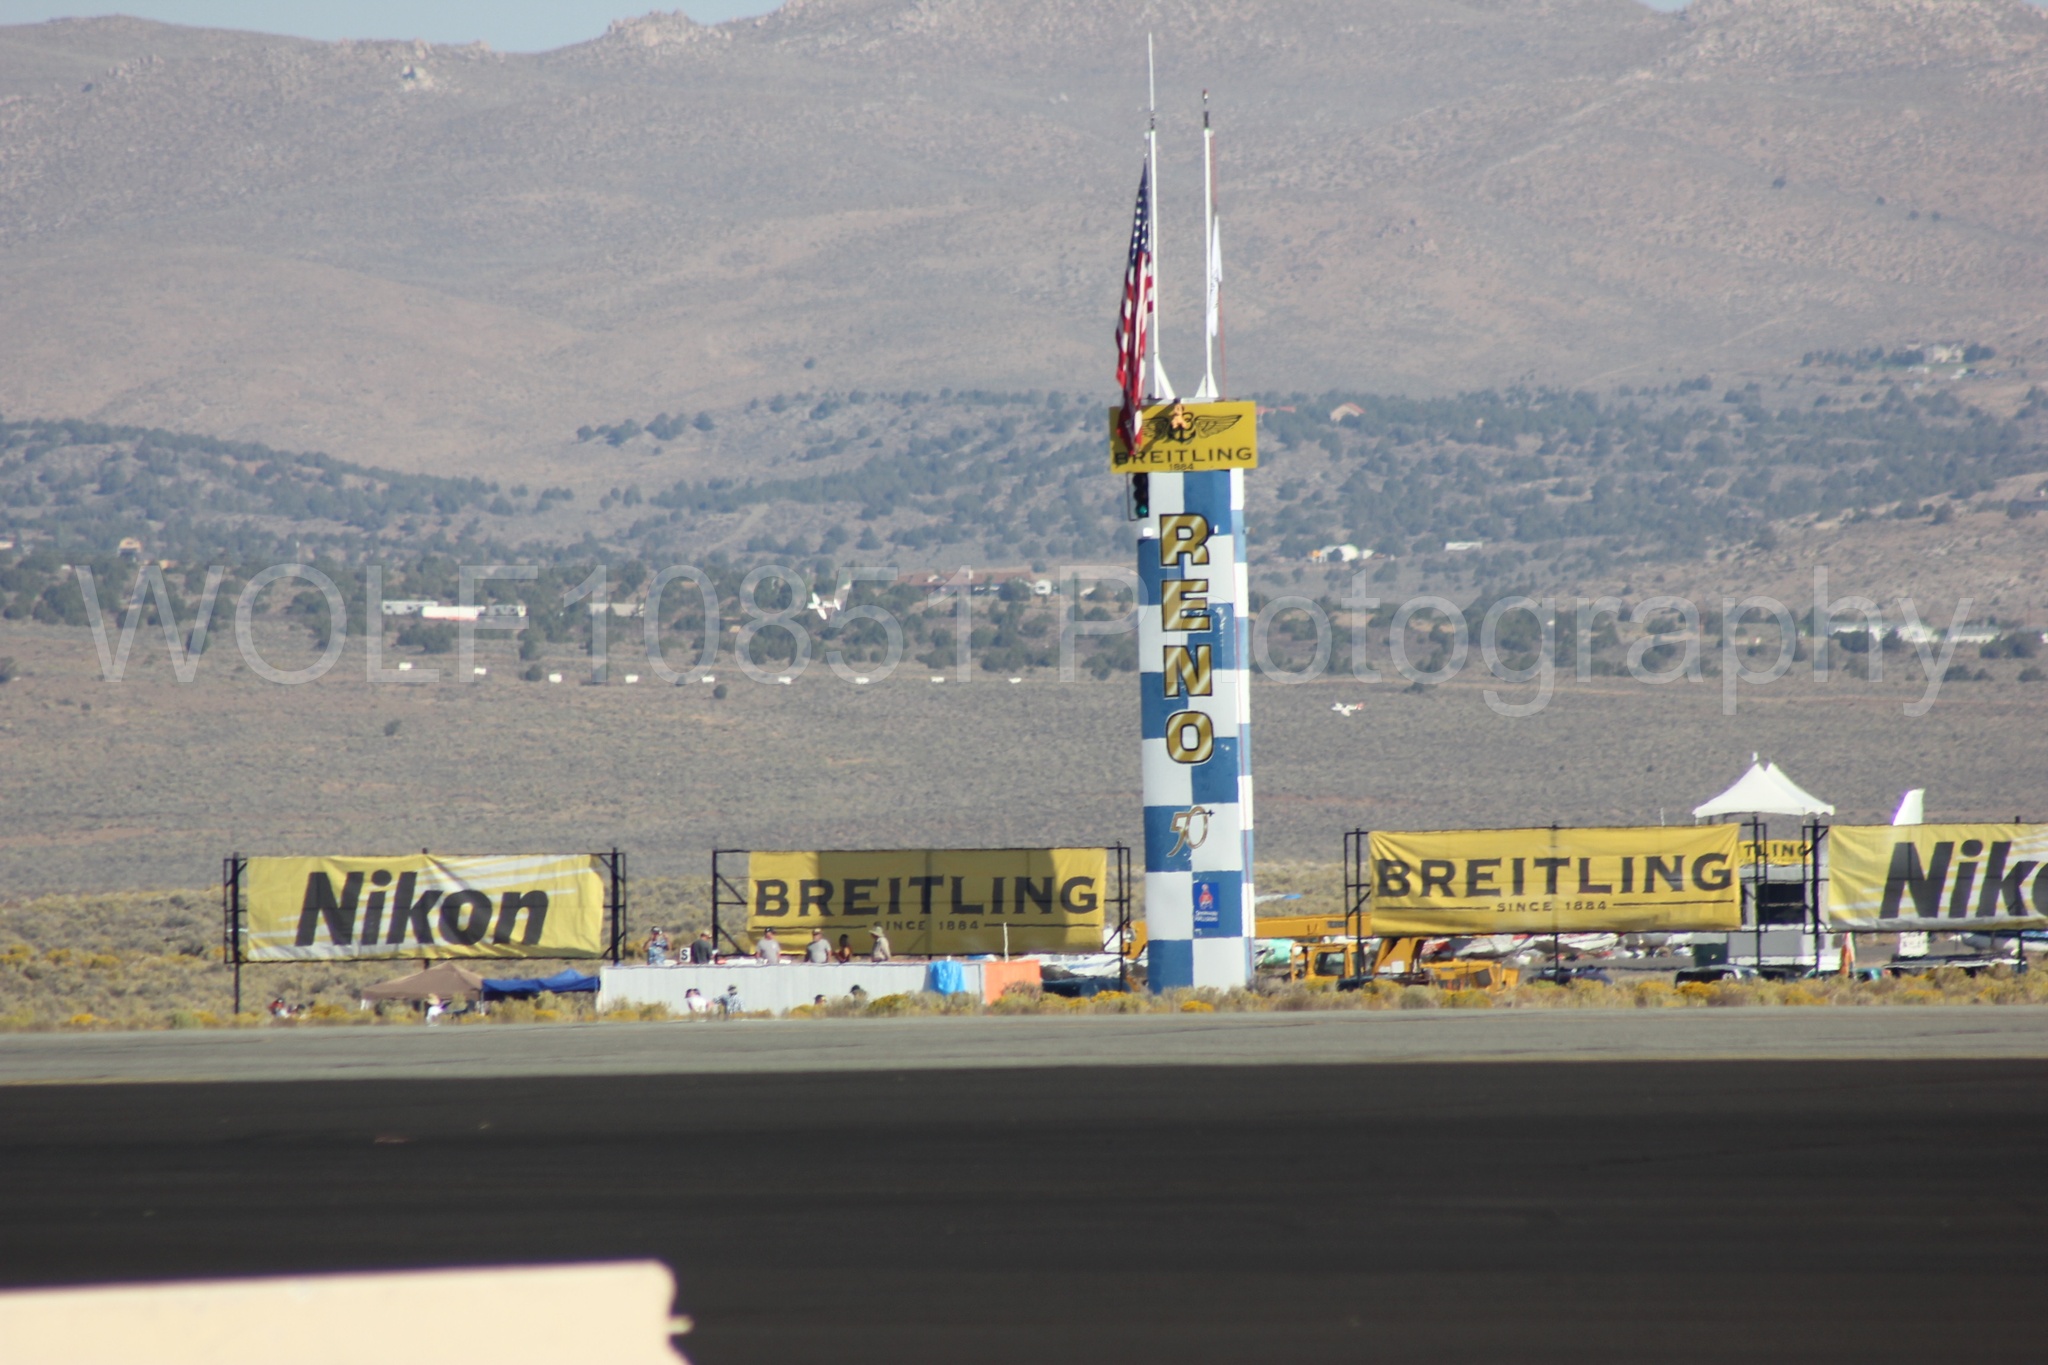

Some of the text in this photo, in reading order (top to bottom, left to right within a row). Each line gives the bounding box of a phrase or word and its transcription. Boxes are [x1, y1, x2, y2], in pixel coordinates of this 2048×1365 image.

[1115, 447, 1252, 466] BREITLING
[1169, 463, 1194, 471] 1884
[1158, 513, 1214, 765] RENO
[1375, 852, 1733, 898] BREITLING
[294, 869, 549, 946] Nikon
[755, 874, 1099, 917] BREITLING
[1497, 900, 1607, 912] SINCE 1884
[939, 920, 979, 931] 1884
